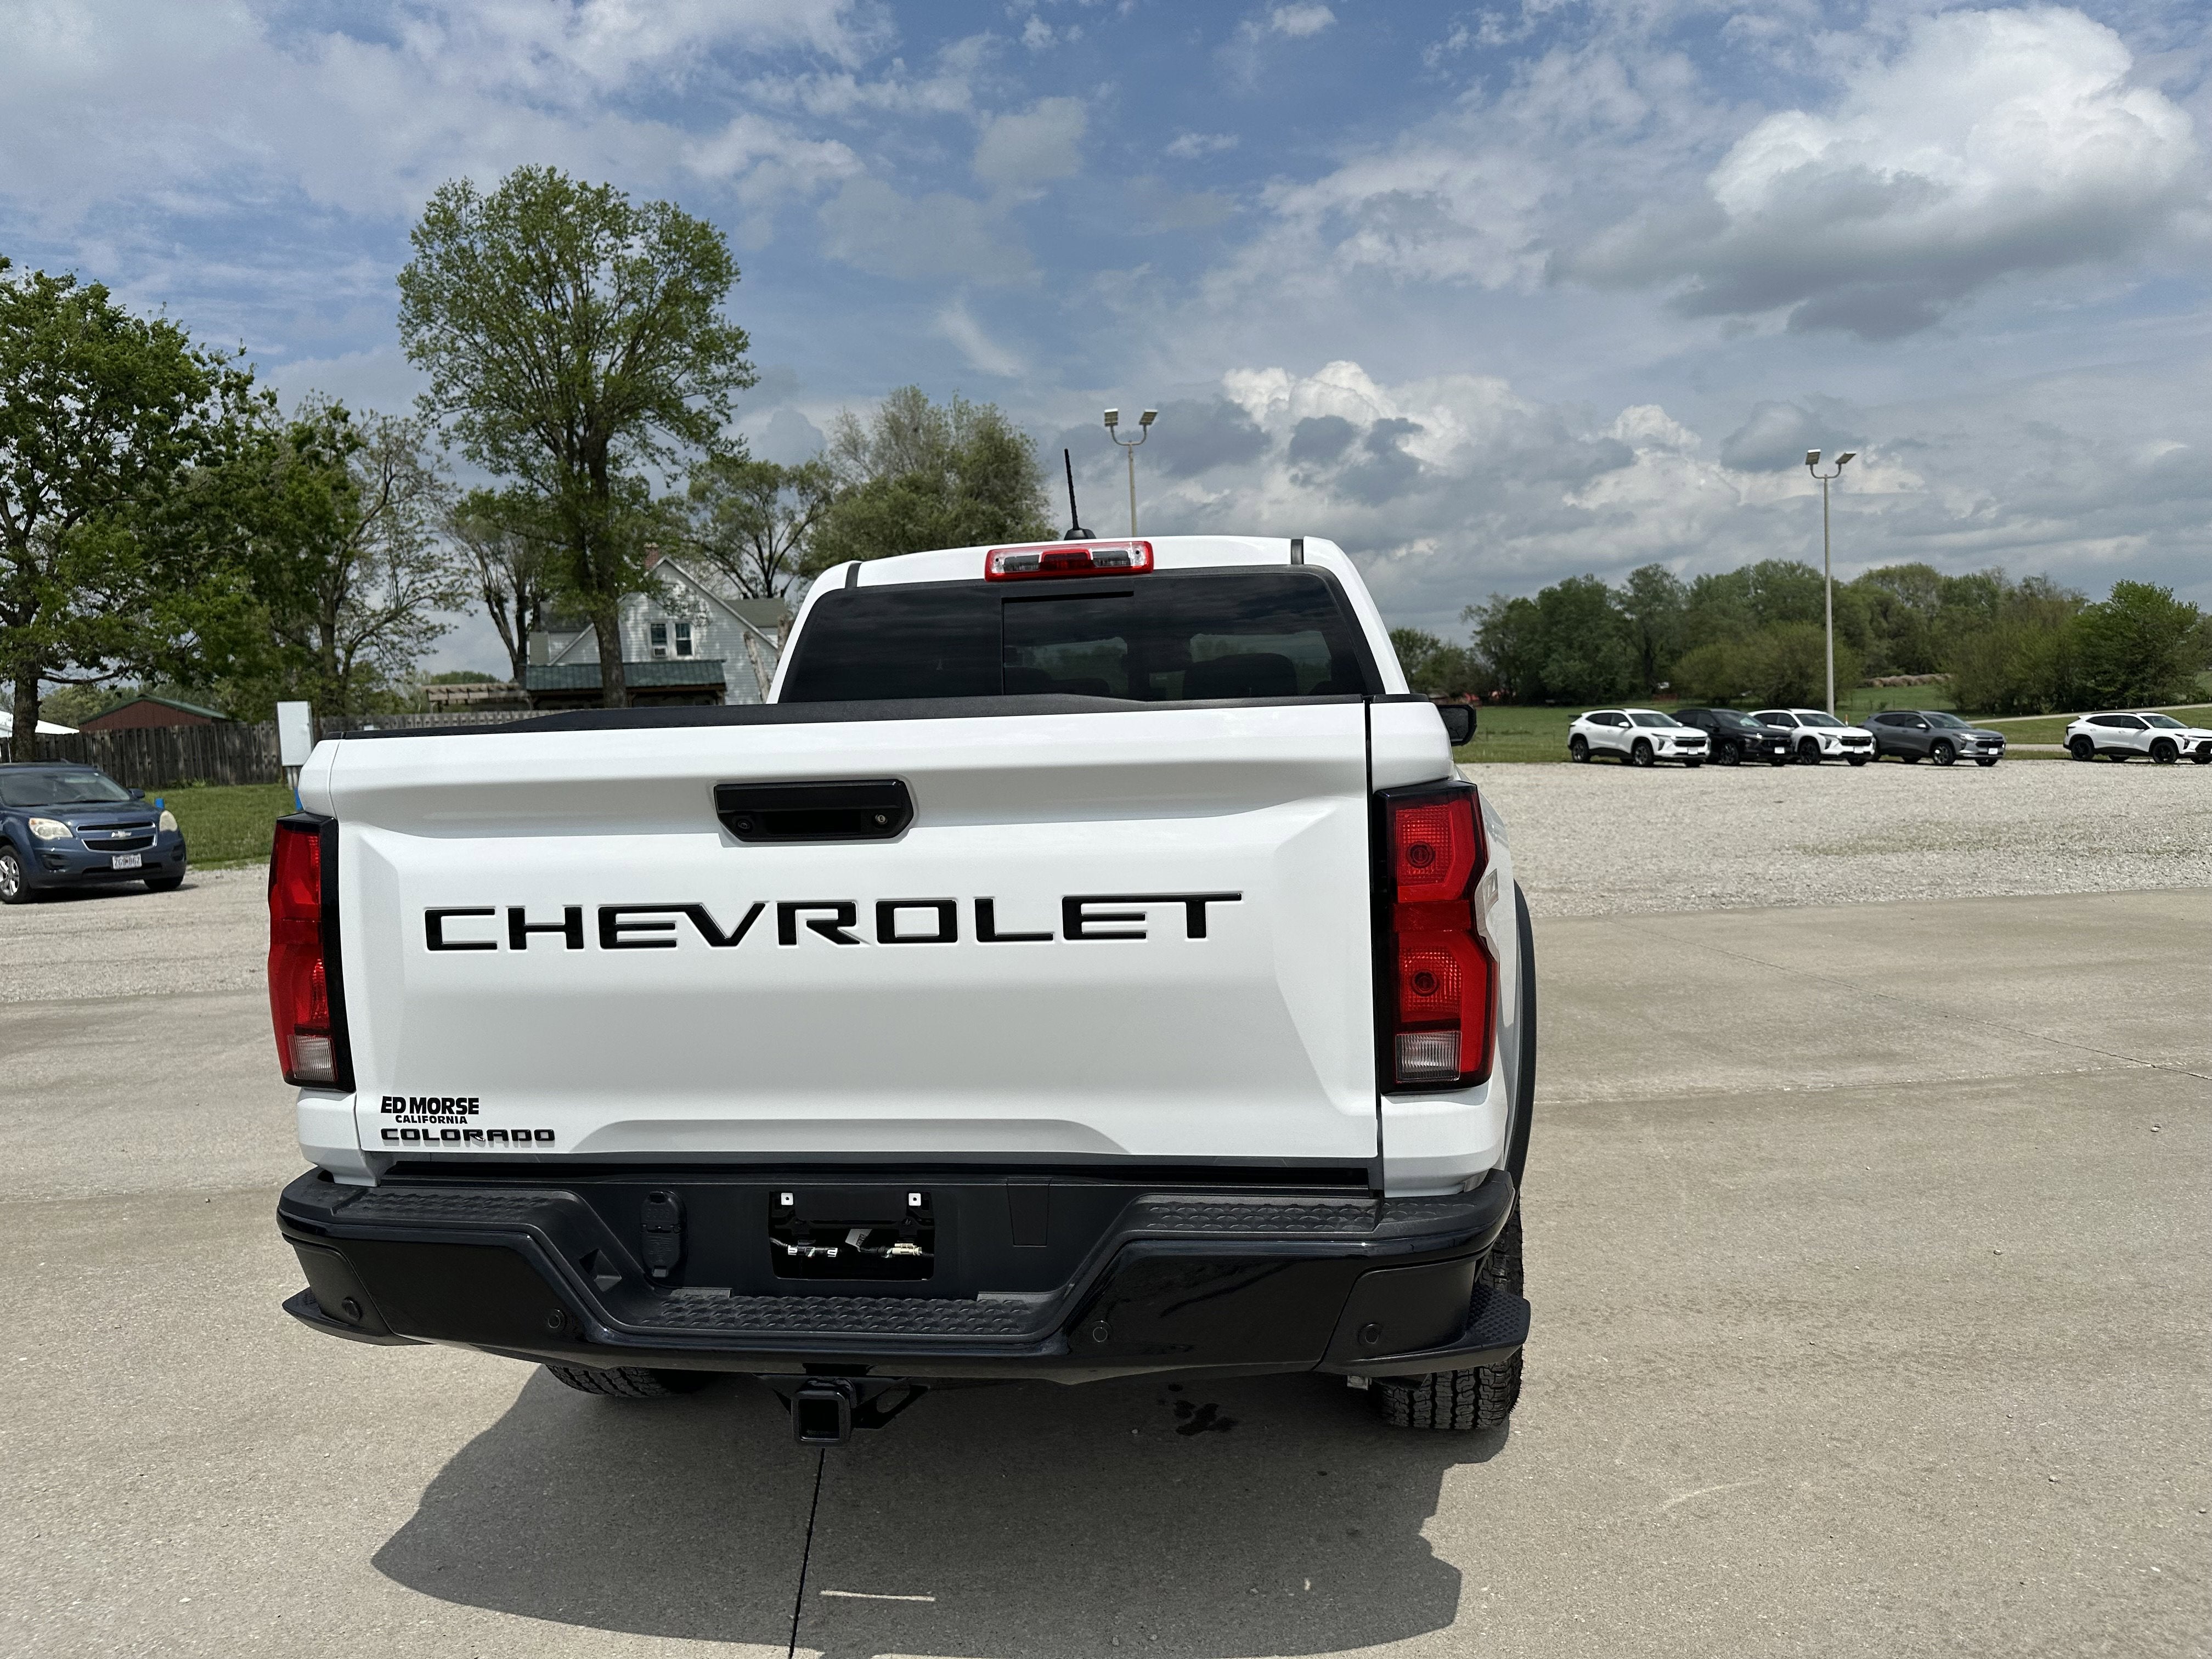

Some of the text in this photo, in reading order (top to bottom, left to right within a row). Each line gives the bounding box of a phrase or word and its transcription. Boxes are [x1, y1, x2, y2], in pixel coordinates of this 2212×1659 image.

[425, 893, 1242, 951] CHEVROLET
[381, 1096, 479, 1115] ED MORSE
[395, 1115, 468, 1124] CALIFORNIA
[381, 1128, 555, 1142] COLORADO
